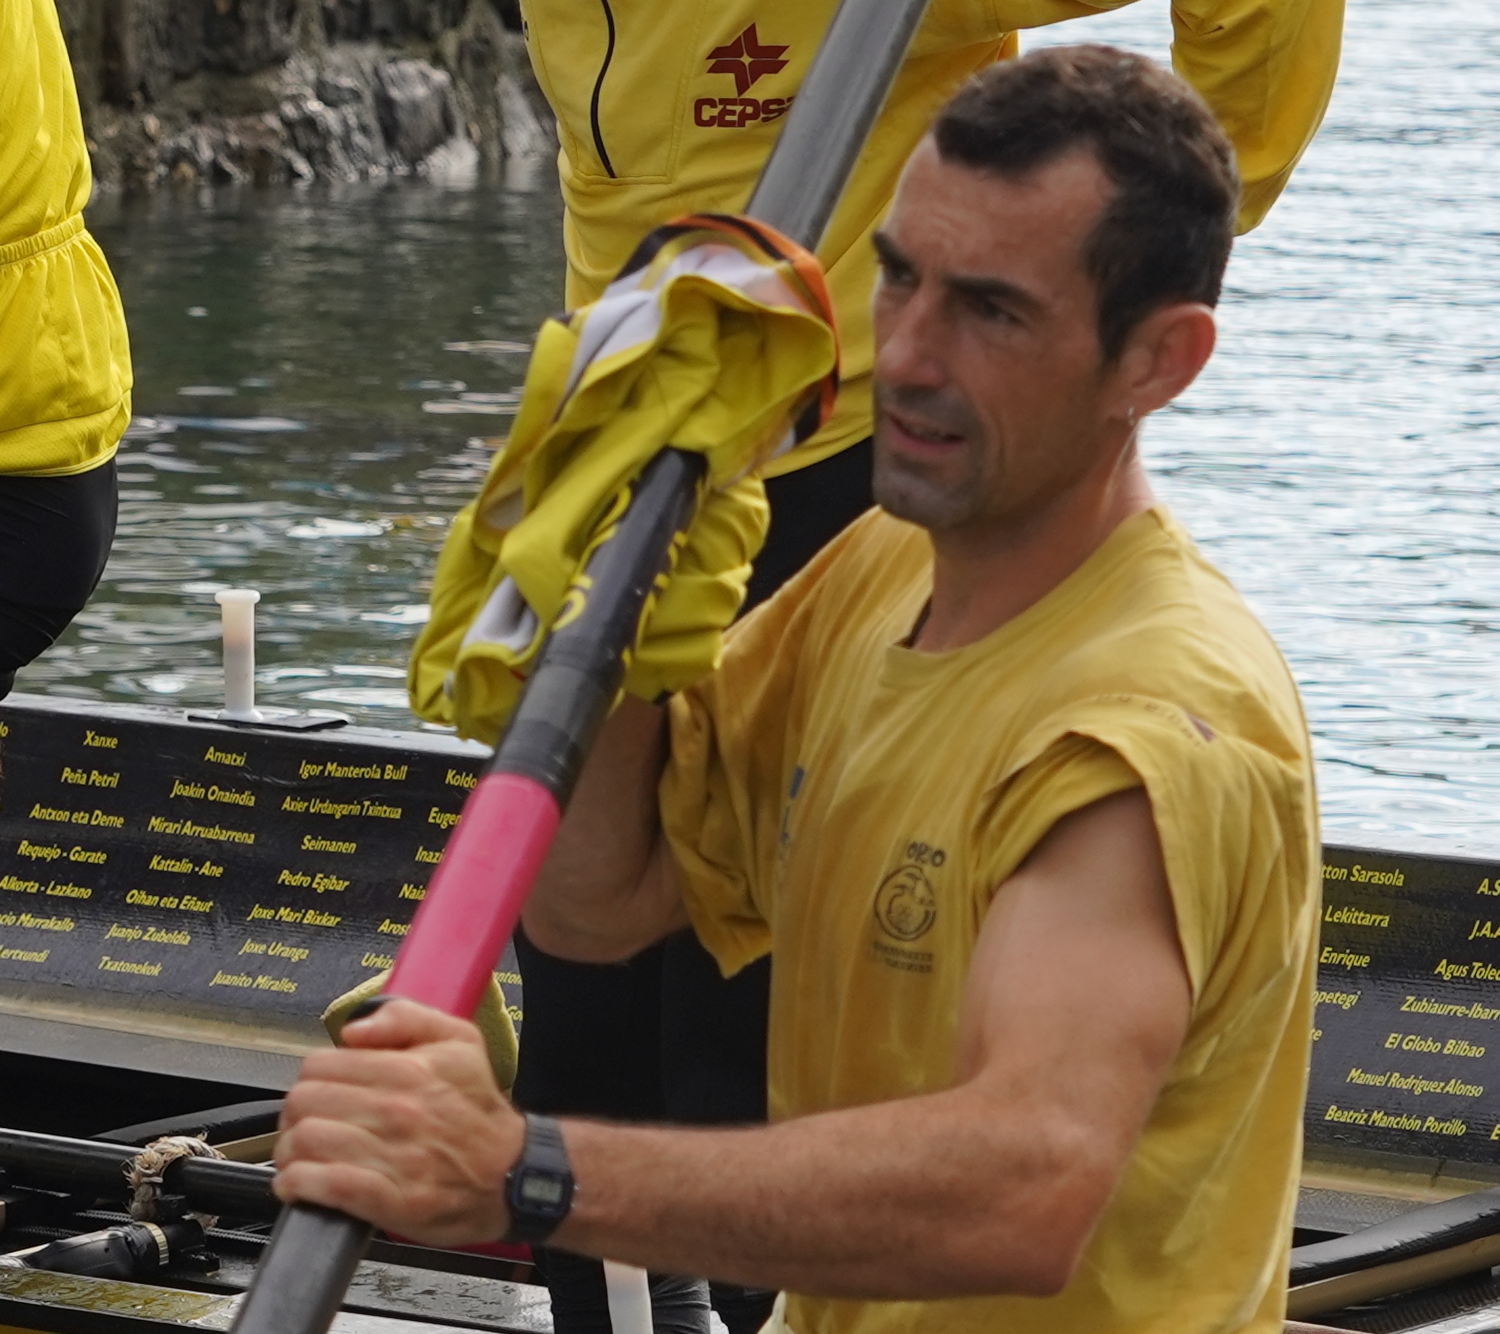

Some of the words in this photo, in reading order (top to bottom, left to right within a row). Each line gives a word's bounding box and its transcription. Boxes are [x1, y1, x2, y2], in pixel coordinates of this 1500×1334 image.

[84, 731, 118, 749] Xanxe
[205, 747, 246, 767] Amatxi
[61, 768, 86, 785] Peña
[89, 770, 118, 789] Petril
[300, 760, 323, 779] Igor
[325, 762, 381, 780] Manterola
[384, 765, 407, 780] Bull
[170, 780, 205, 799] Joakin
[208, 789, 255, 807] Onaindia
[29, 804, 69, 823] Antxon
[72, 810, 89, 824] eta
[91, 810, 124, 828] Deme
[282, 796, 308, 812] Axier
[309, 798, 361, 819] Urdangarin
[148, 816, 183, 835] Mirari
[182, 821, 255, 844] Arruabarrena
[18, 841, 61, 862] Requejo
[70, 847, 107, 864] Garate
[302, 836, 356, 854] Seimanen
[149, 856, 192, 875] Kattalin
[199, 864, 223, 877] Ane
[1350, 865, 1404, 886] Sarasola
[46, 881, 92, 899] Lazkano
[278, 871, 310, 888] Pedro
[312, 874, 349, 893] Egibar
[126, 890, 158, 906] Oihan
[160, 896, 178, 908] eta
[180, 896, 213, 913] Eñaut
[16, 914, 75, 932] Marrakallo
[247, 903, 275, 921] Joxe
[275, 907, 303, 923] Mari
[303, 909, 341, 928] Bixkar
[1324, 906, 1390, 927] Lekittarra
[105, 923, 142, 942] Juanjo
[142, 926, 191, 946] Zubeldia
[238, 939, 266, 956] Joxe
[268, 939, 309, 962] Uranga
[1320, 947, 1370, 969] Enrique
[98, 957, 162, 977] Txatonekok
[1434, 959, 1469, 979] Agus
[209, 970, 252, 987] Juanito
[252, 974, 297, 993] Miralles
[1385, 1034, 1400, 1048] El
[1401, 1035, 1441, 1053] Globo
[1443, 1039, 1485, 1058] Bilbao
[1346, 1068, 1389, 1087] Manuel
[1446, 1079, 1484, 1097] Alonso
[1324, 1105, 1368, 1125] Beatriz
[1368, 1111, 1421, 1130] Manchón
[1422, 1117, 1466, 1136] Portillo
